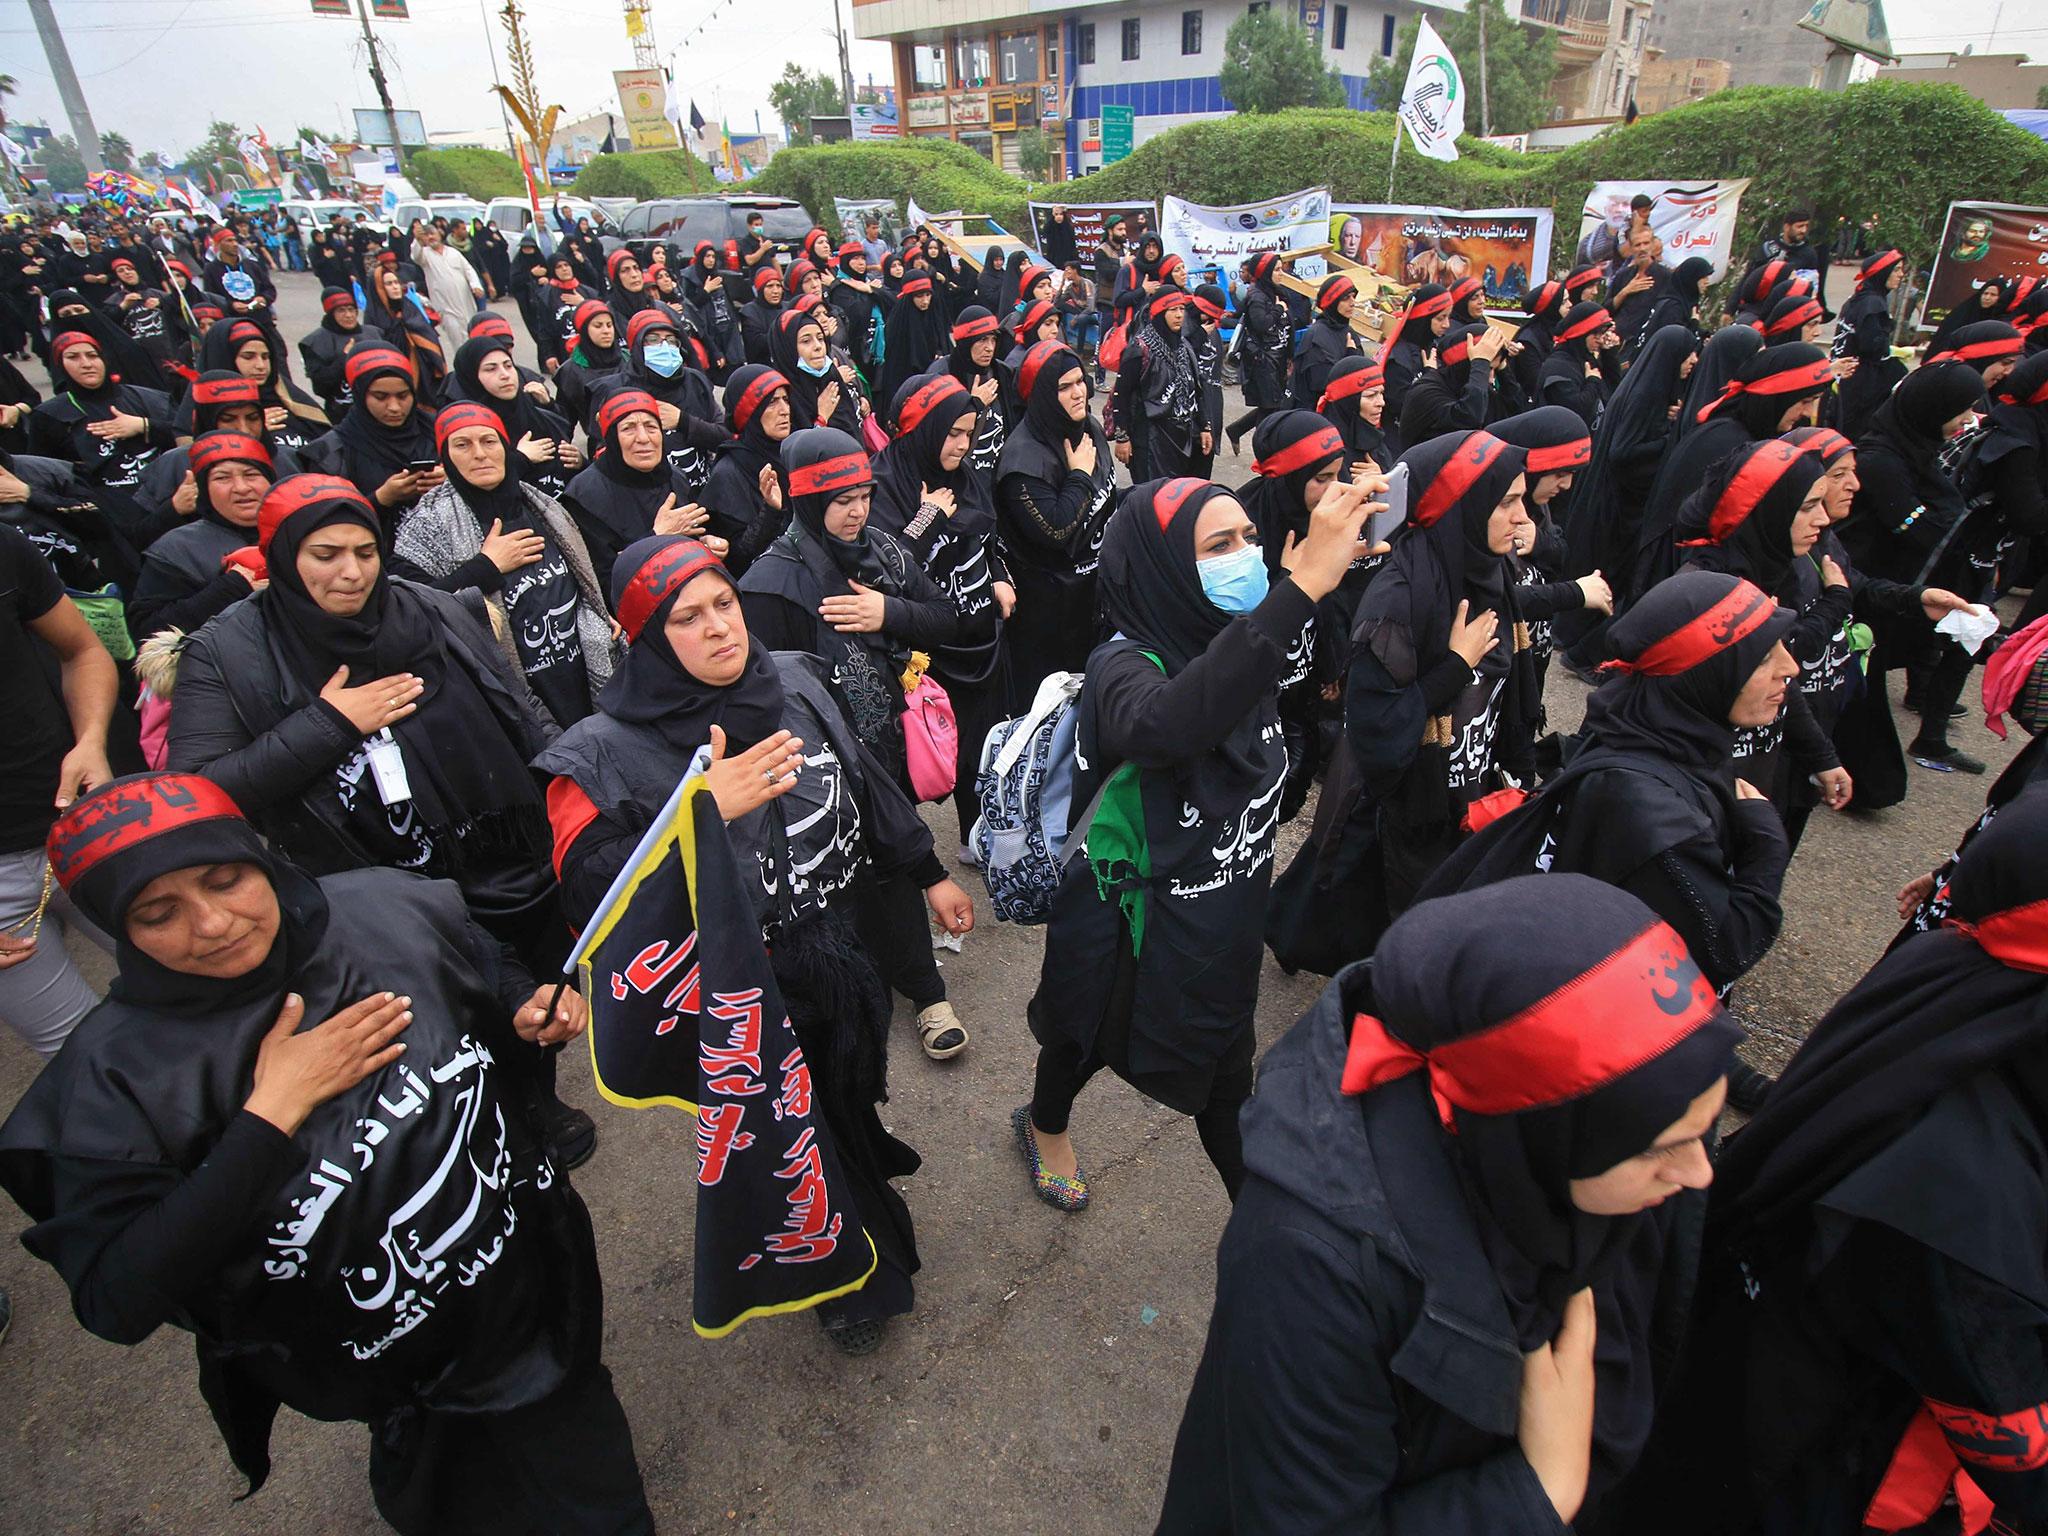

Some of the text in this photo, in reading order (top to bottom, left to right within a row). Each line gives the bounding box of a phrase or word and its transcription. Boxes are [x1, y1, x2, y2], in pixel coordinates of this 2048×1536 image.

[1402, 221, 1424, 237] مرتين
[1461, 226, 1472, 240] لن
[1473, 224, 1503, 240] الشهداء
[1503, 227, 1528, 241] بدماء
[1192, 236, 1245, 260] الشرعية
[1670, 231, 1718, 250] العراق
[1278, 667, 1308, 690] القصيب
[1170, 867, 1233, 899] القصيبة
[737, 1126, 845, 1273] الحسين
